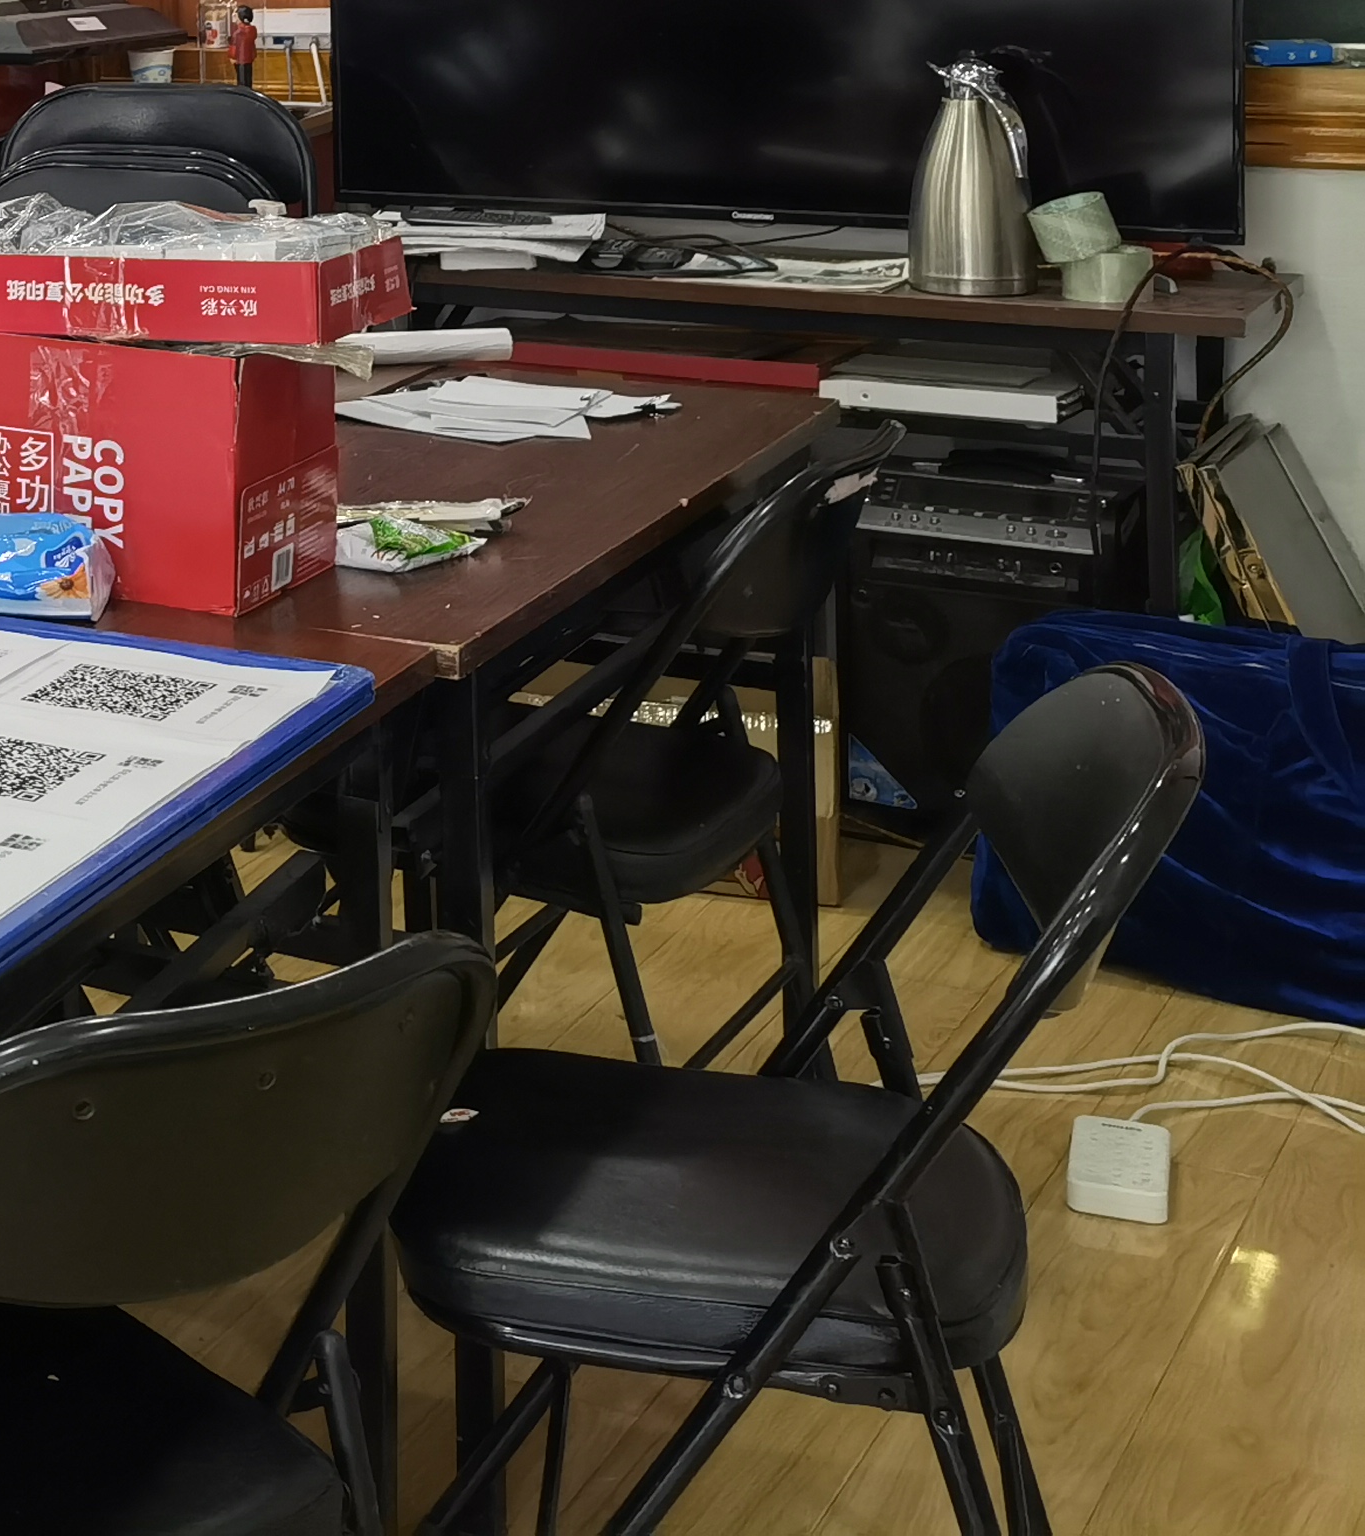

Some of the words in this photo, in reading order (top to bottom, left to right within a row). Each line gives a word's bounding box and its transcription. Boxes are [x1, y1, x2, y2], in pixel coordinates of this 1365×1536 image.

[6, 279, 165, 307] 多功能办公复印纸
[199, 285, 215, 294] CAI
[217, 285, 239, 295] XING
[241, 285, 257, 295] XIN
[200, 298, 258, 317] 欣兴彩
[94, 439, 125, 549] COPY
